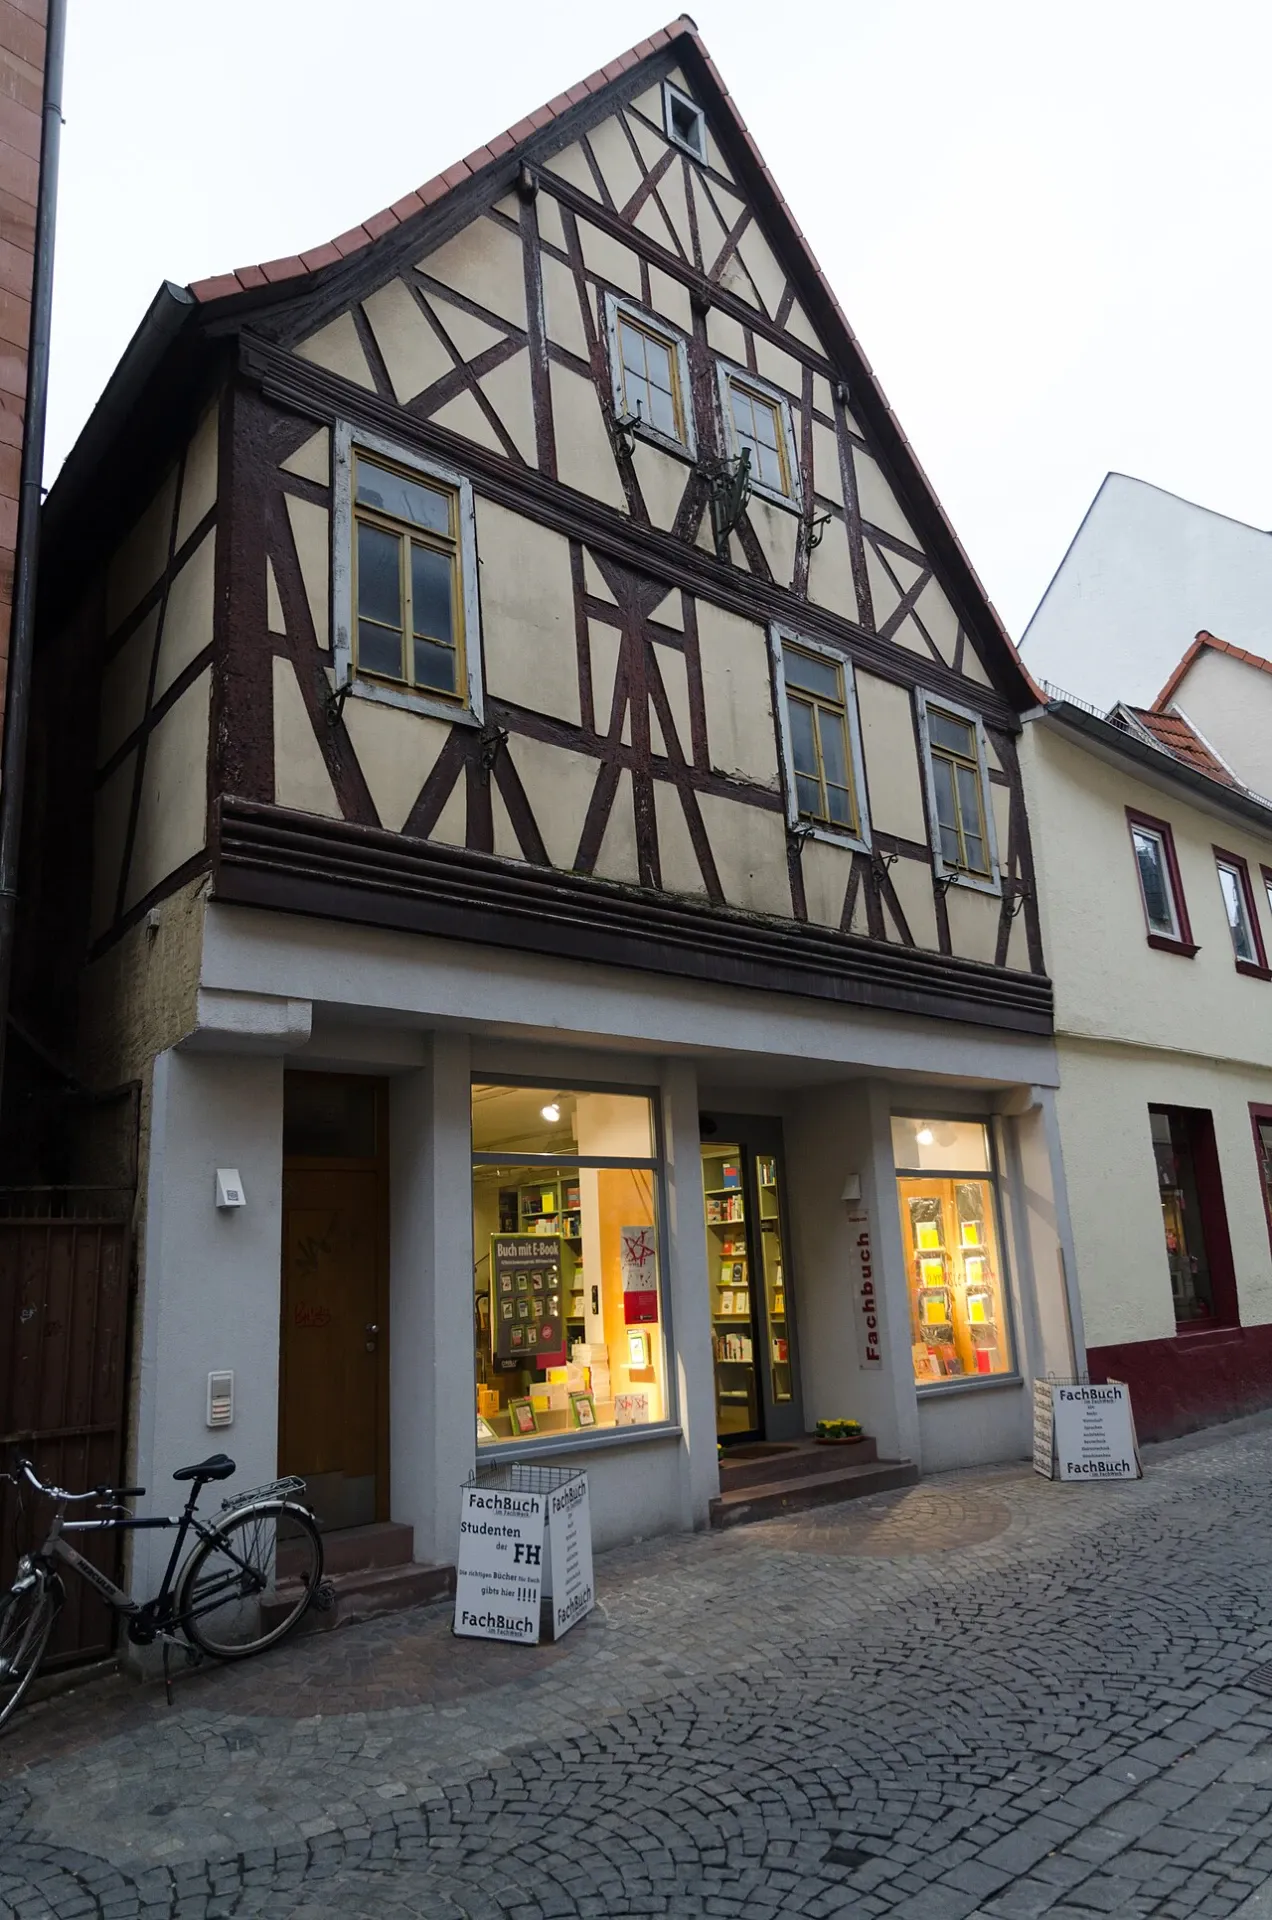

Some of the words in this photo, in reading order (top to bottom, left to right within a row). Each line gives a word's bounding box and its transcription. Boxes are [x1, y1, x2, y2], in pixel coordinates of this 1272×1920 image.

[497, 1242, 517, 1257] Buch
[518, 1242, 532, 1256] mit
[532, 1241, 559, 1256] E-Book
[857, 1232, 880, 1361] Fachbuch
[1059, 1386, 1122, 1401] FachBuch
[1067, 1459, 1130, 1474] FachBuch
[469, 1494, 539, 1513] FachBuch
[553, 1479, 586, 1514] FachBuch
[460, 1521, 521, 1538] Studenten
[496, 1541, 508, 1550] der
[513, 1542, 541, 1565] FH
[468, 1570, 492, 1579] richtigen
[493, 1571, 517, 1582] Bücher
[481, 1586, 500, 1596] gibts
[501, 1587, 515, 1597] hier
[558, 1584, 592, 1626] FachBuch
[462, 1610, 533, 1633] FachBuch
